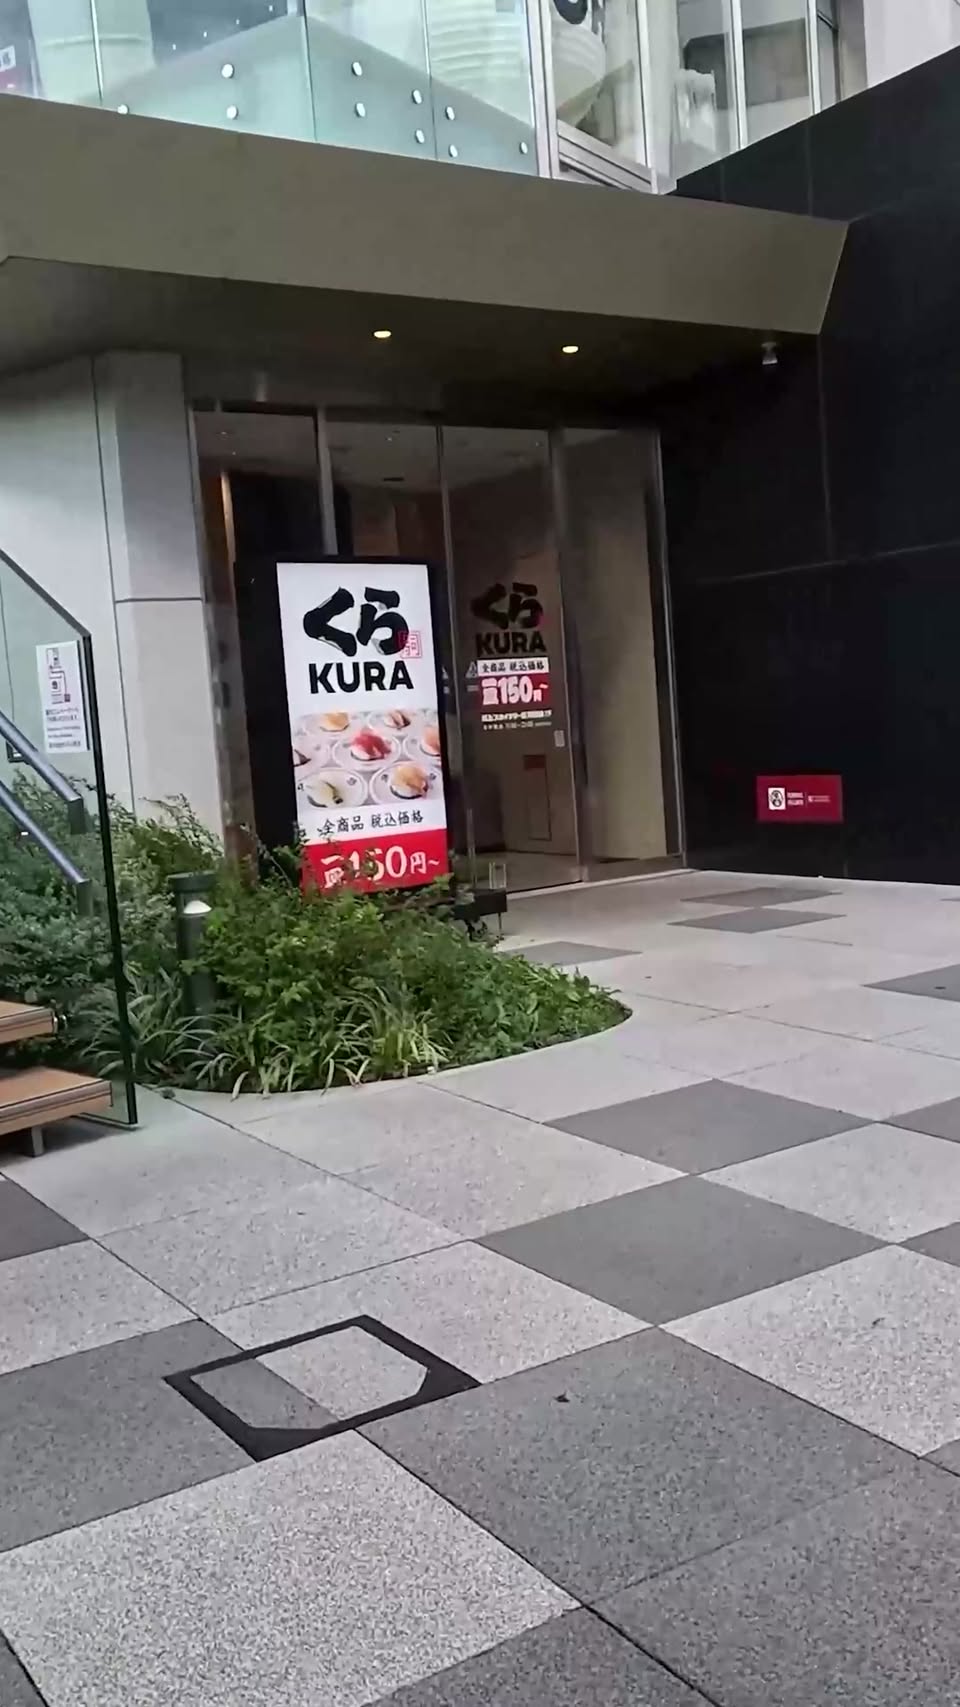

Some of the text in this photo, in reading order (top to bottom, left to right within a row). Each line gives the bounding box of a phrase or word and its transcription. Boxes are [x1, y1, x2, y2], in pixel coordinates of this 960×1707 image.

[303, 586, 409, 656] くら
[470, 582, 543, 629] くら
[475, 630, 547, 656] KURA
[309, 660, 414, 694] KURA
[322, 810, 424, 836] 全商品 税込価格
